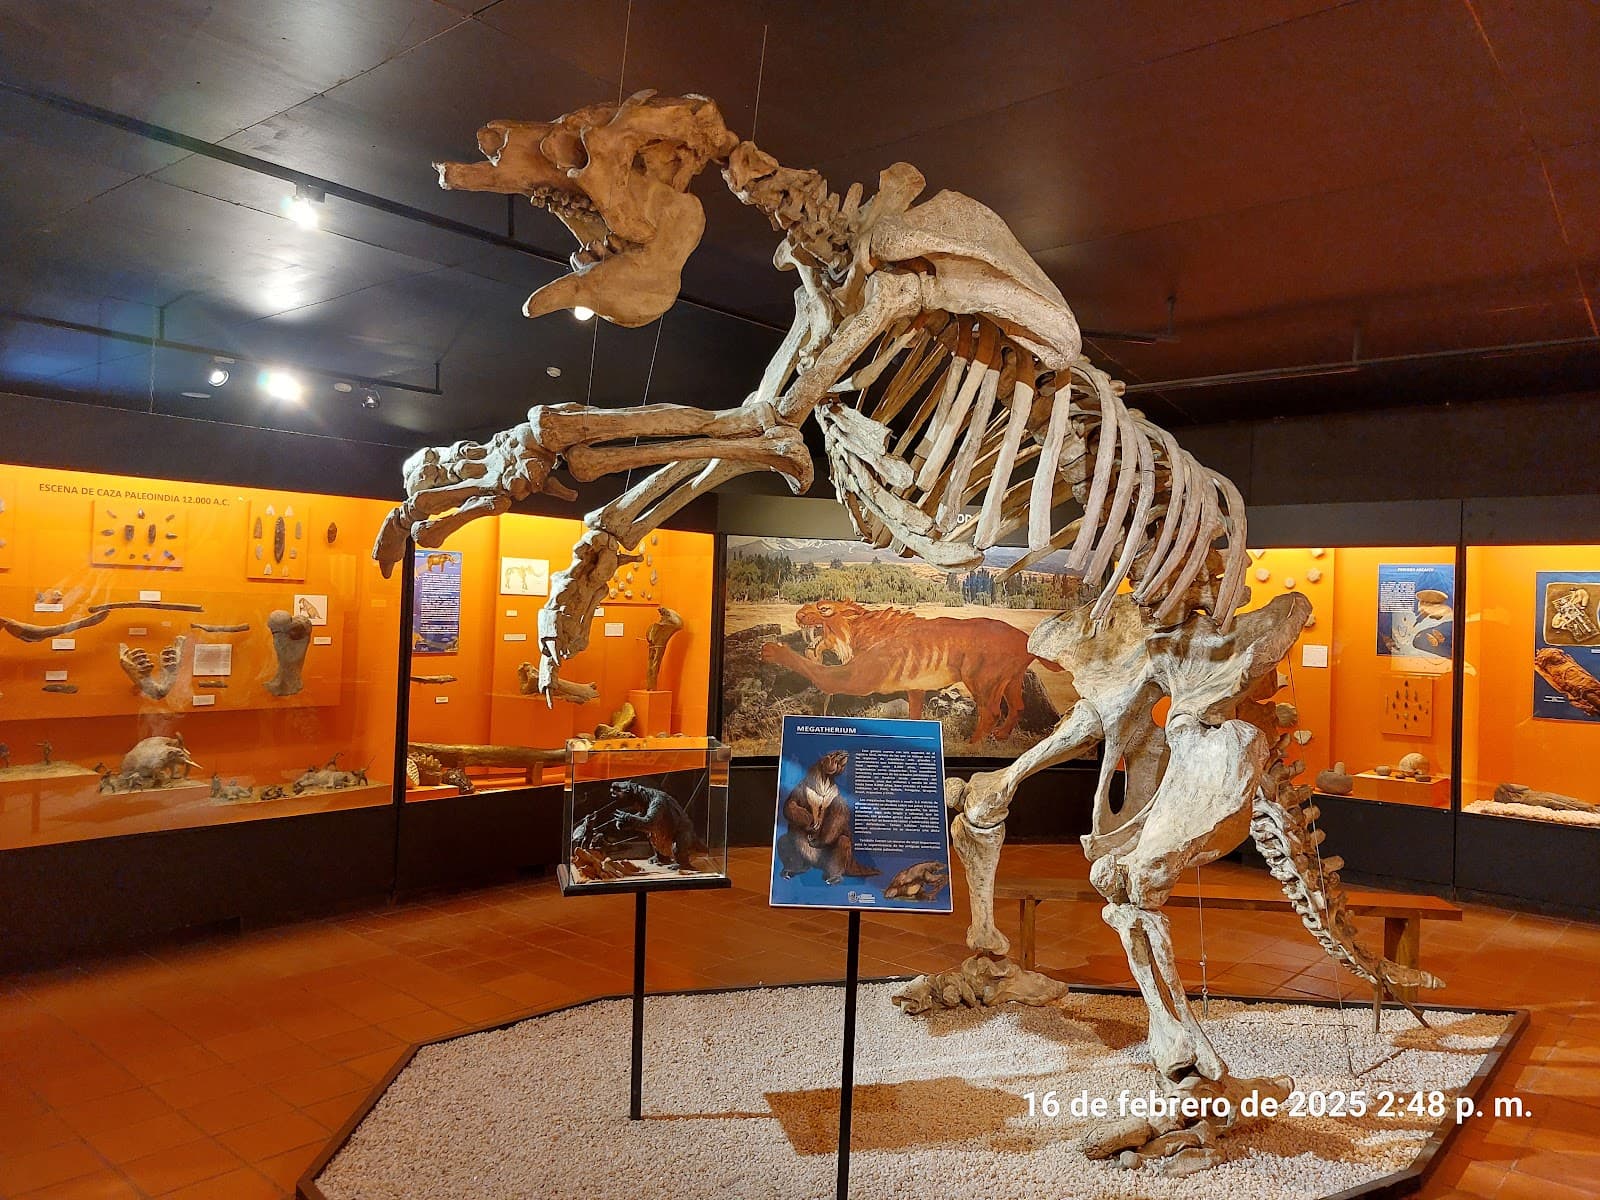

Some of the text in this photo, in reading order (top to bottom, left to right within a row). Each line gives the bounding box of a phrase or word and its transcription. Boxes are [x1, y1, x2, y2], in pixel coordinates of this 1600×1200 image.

[39, 483, 230, 506] ESCENA DE CAZA PALEOINDIA 12.000 A.C.
[796, 725, 856, 734] MEGATHERIUM
